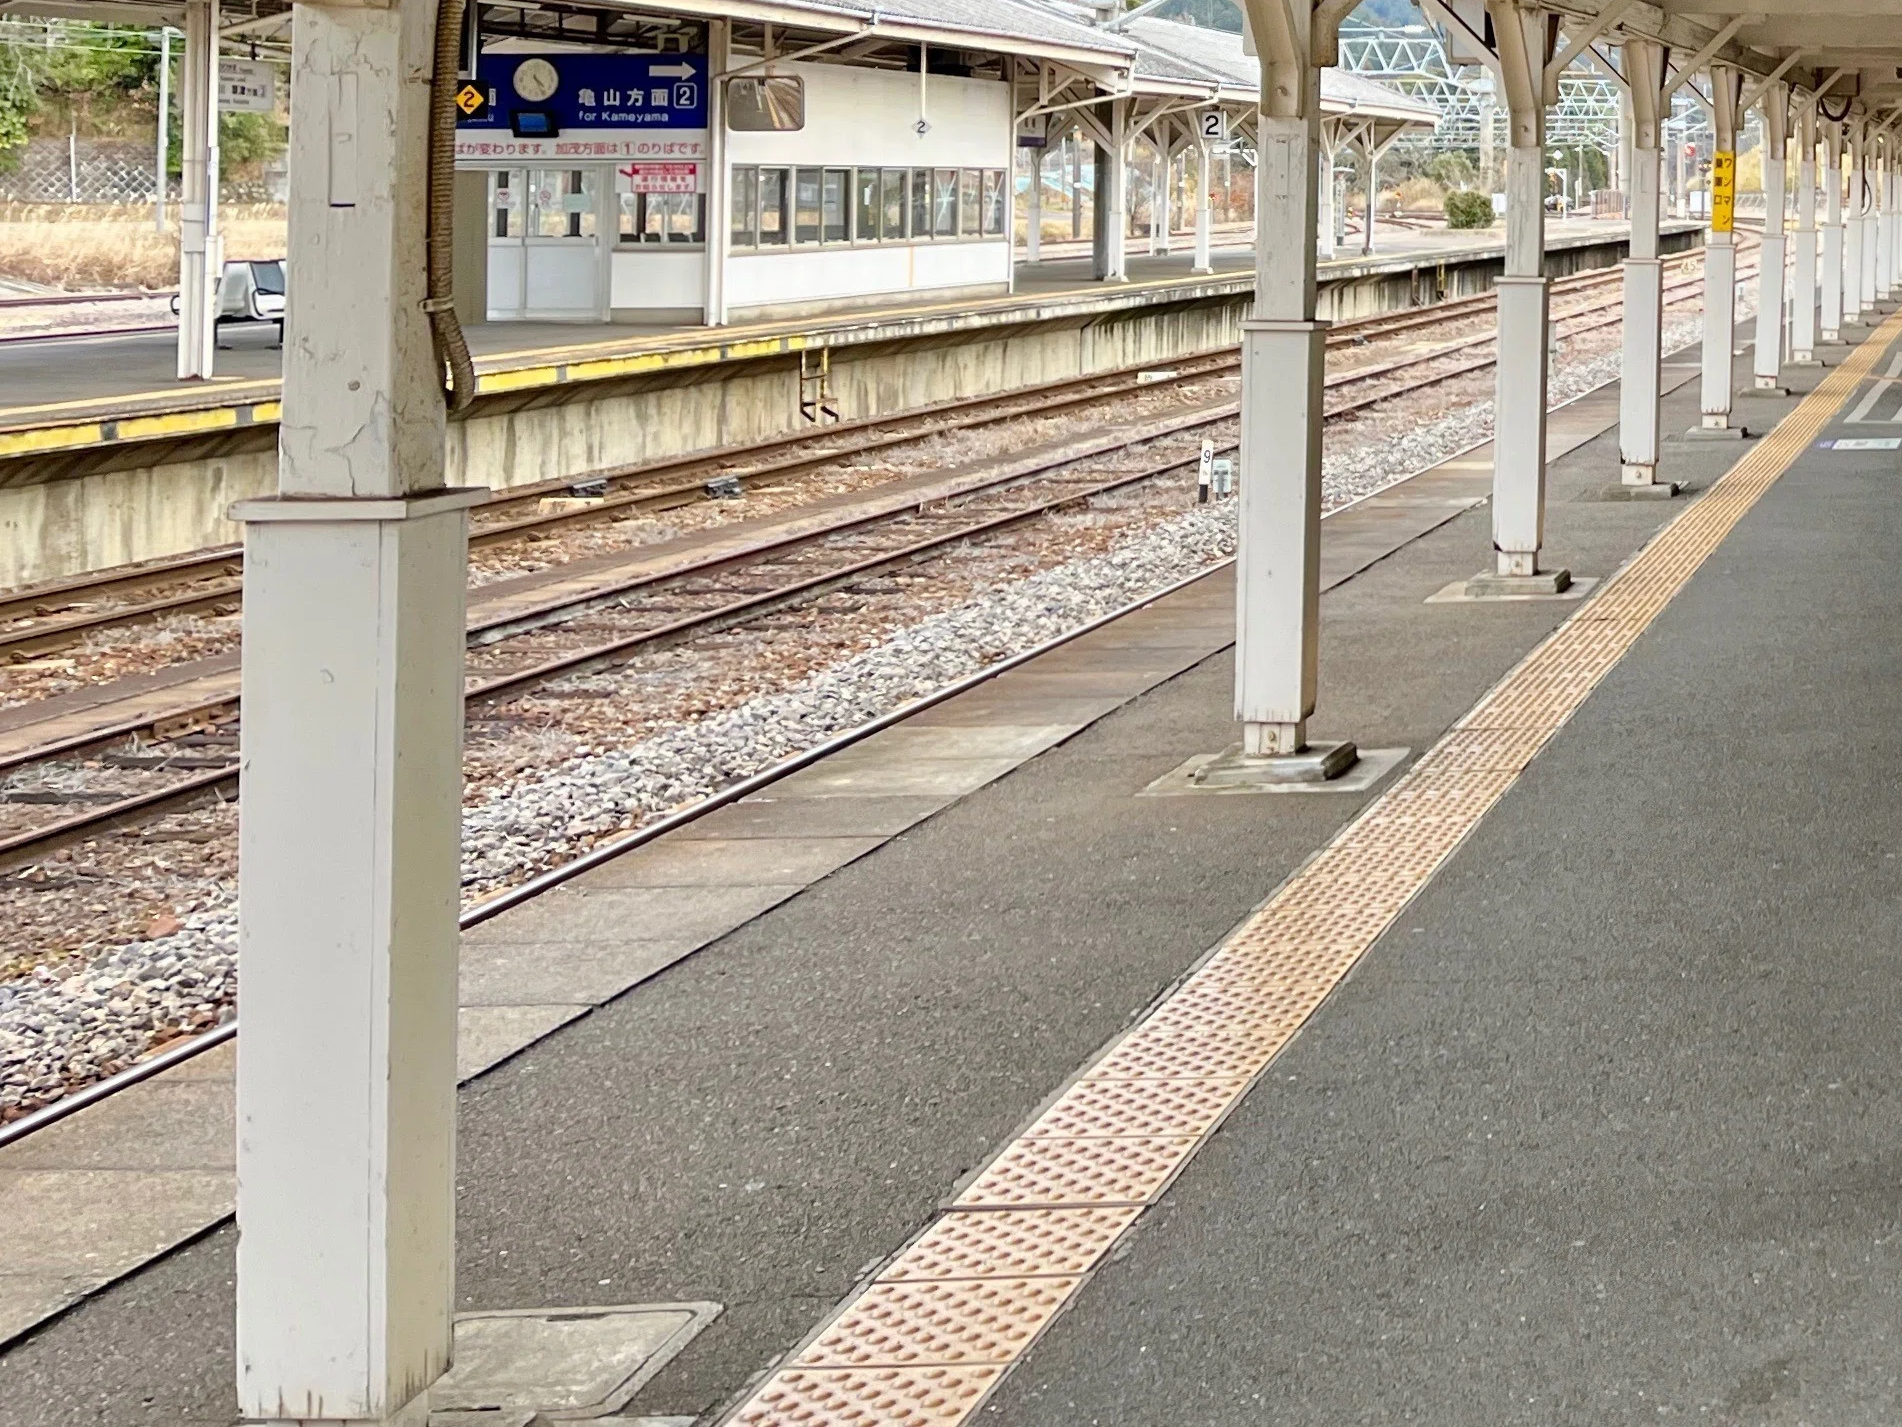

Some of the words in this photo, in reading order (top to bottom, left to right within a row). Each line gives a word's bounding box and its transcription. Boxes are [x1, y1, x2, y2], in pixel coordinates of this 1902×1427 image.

[463, 90, 475, 108] 2
[578, 87, 669, 107] 亀山方面
[679, 86, 691, 105] 2
[578, 110, 597, 122] for
[601, 111, 669, 123] Kameyama
[1205, 114, 1219, 136] 2
[916, 120, 926, 134] 2
[1722, 158, 1733, 225] ワンマン
